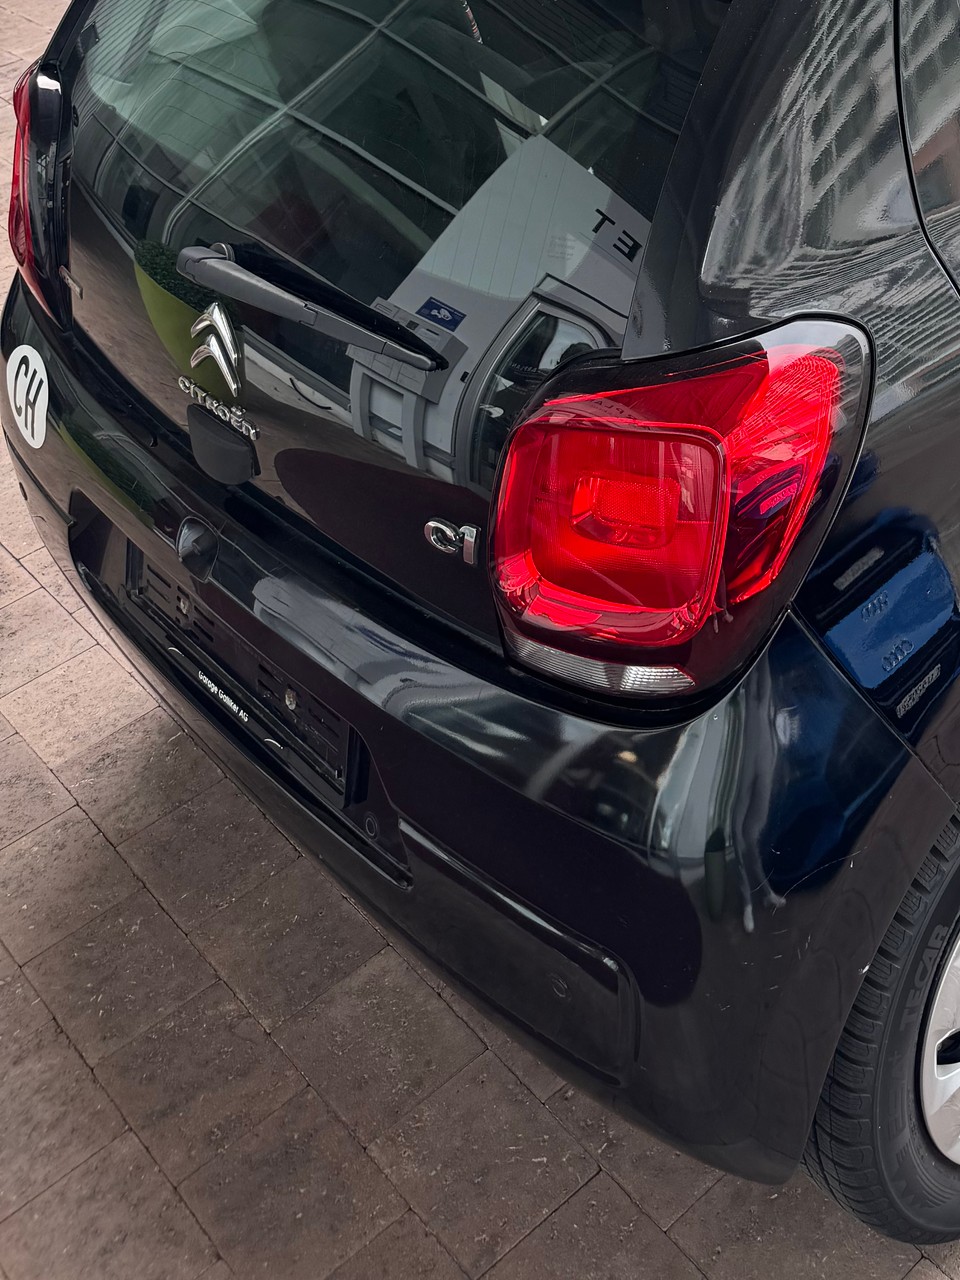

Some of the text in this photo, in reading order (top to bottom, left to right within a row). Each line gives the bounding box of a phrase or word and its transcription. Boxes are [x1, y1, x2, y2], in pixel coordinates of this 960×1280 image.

[13, 354, 44, 441] CH
[424, 518, 479, 565] C1
[198, 670, 218, 694] Garage
[238, 709, 249, 722] AG
